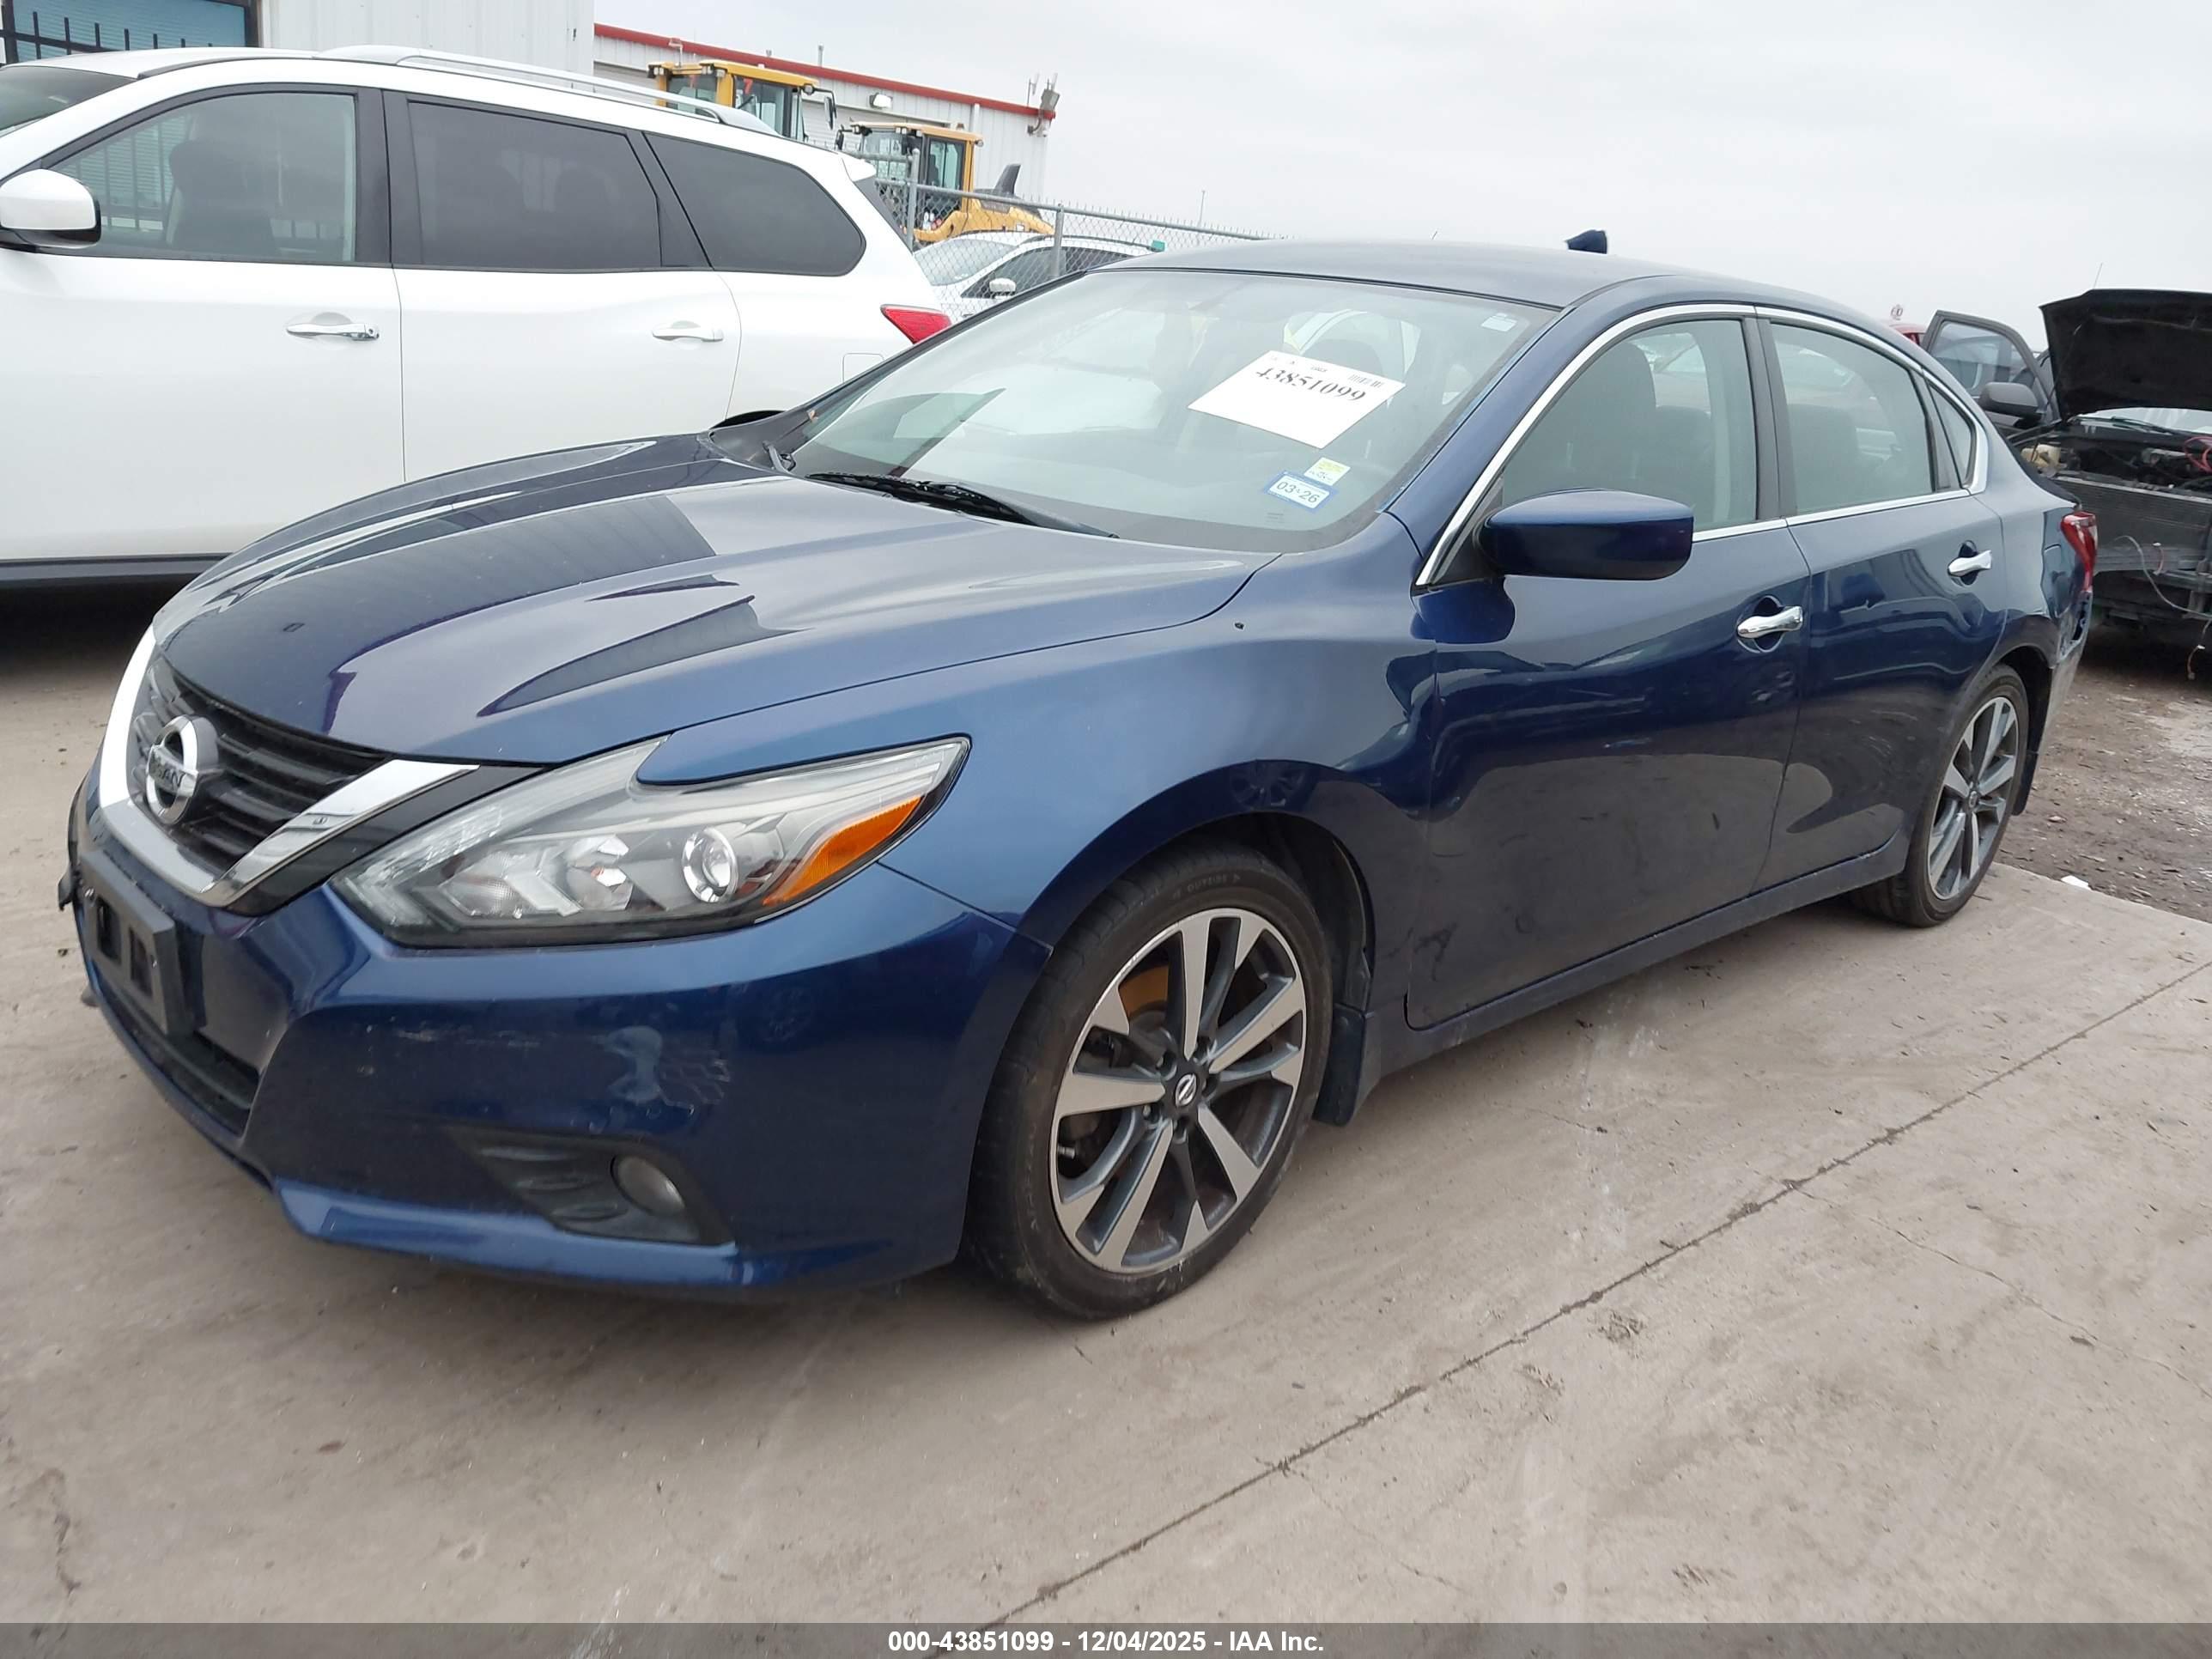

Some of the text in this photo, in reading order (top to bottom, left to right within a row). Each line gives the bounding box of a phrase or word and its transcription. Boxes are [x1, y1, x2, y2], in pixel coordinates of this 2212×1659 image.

[1256, 368, 1365, 400] 43851099
[1276, 481, 1297, 493] 03
[1298, 490, 1320, 503] 26
